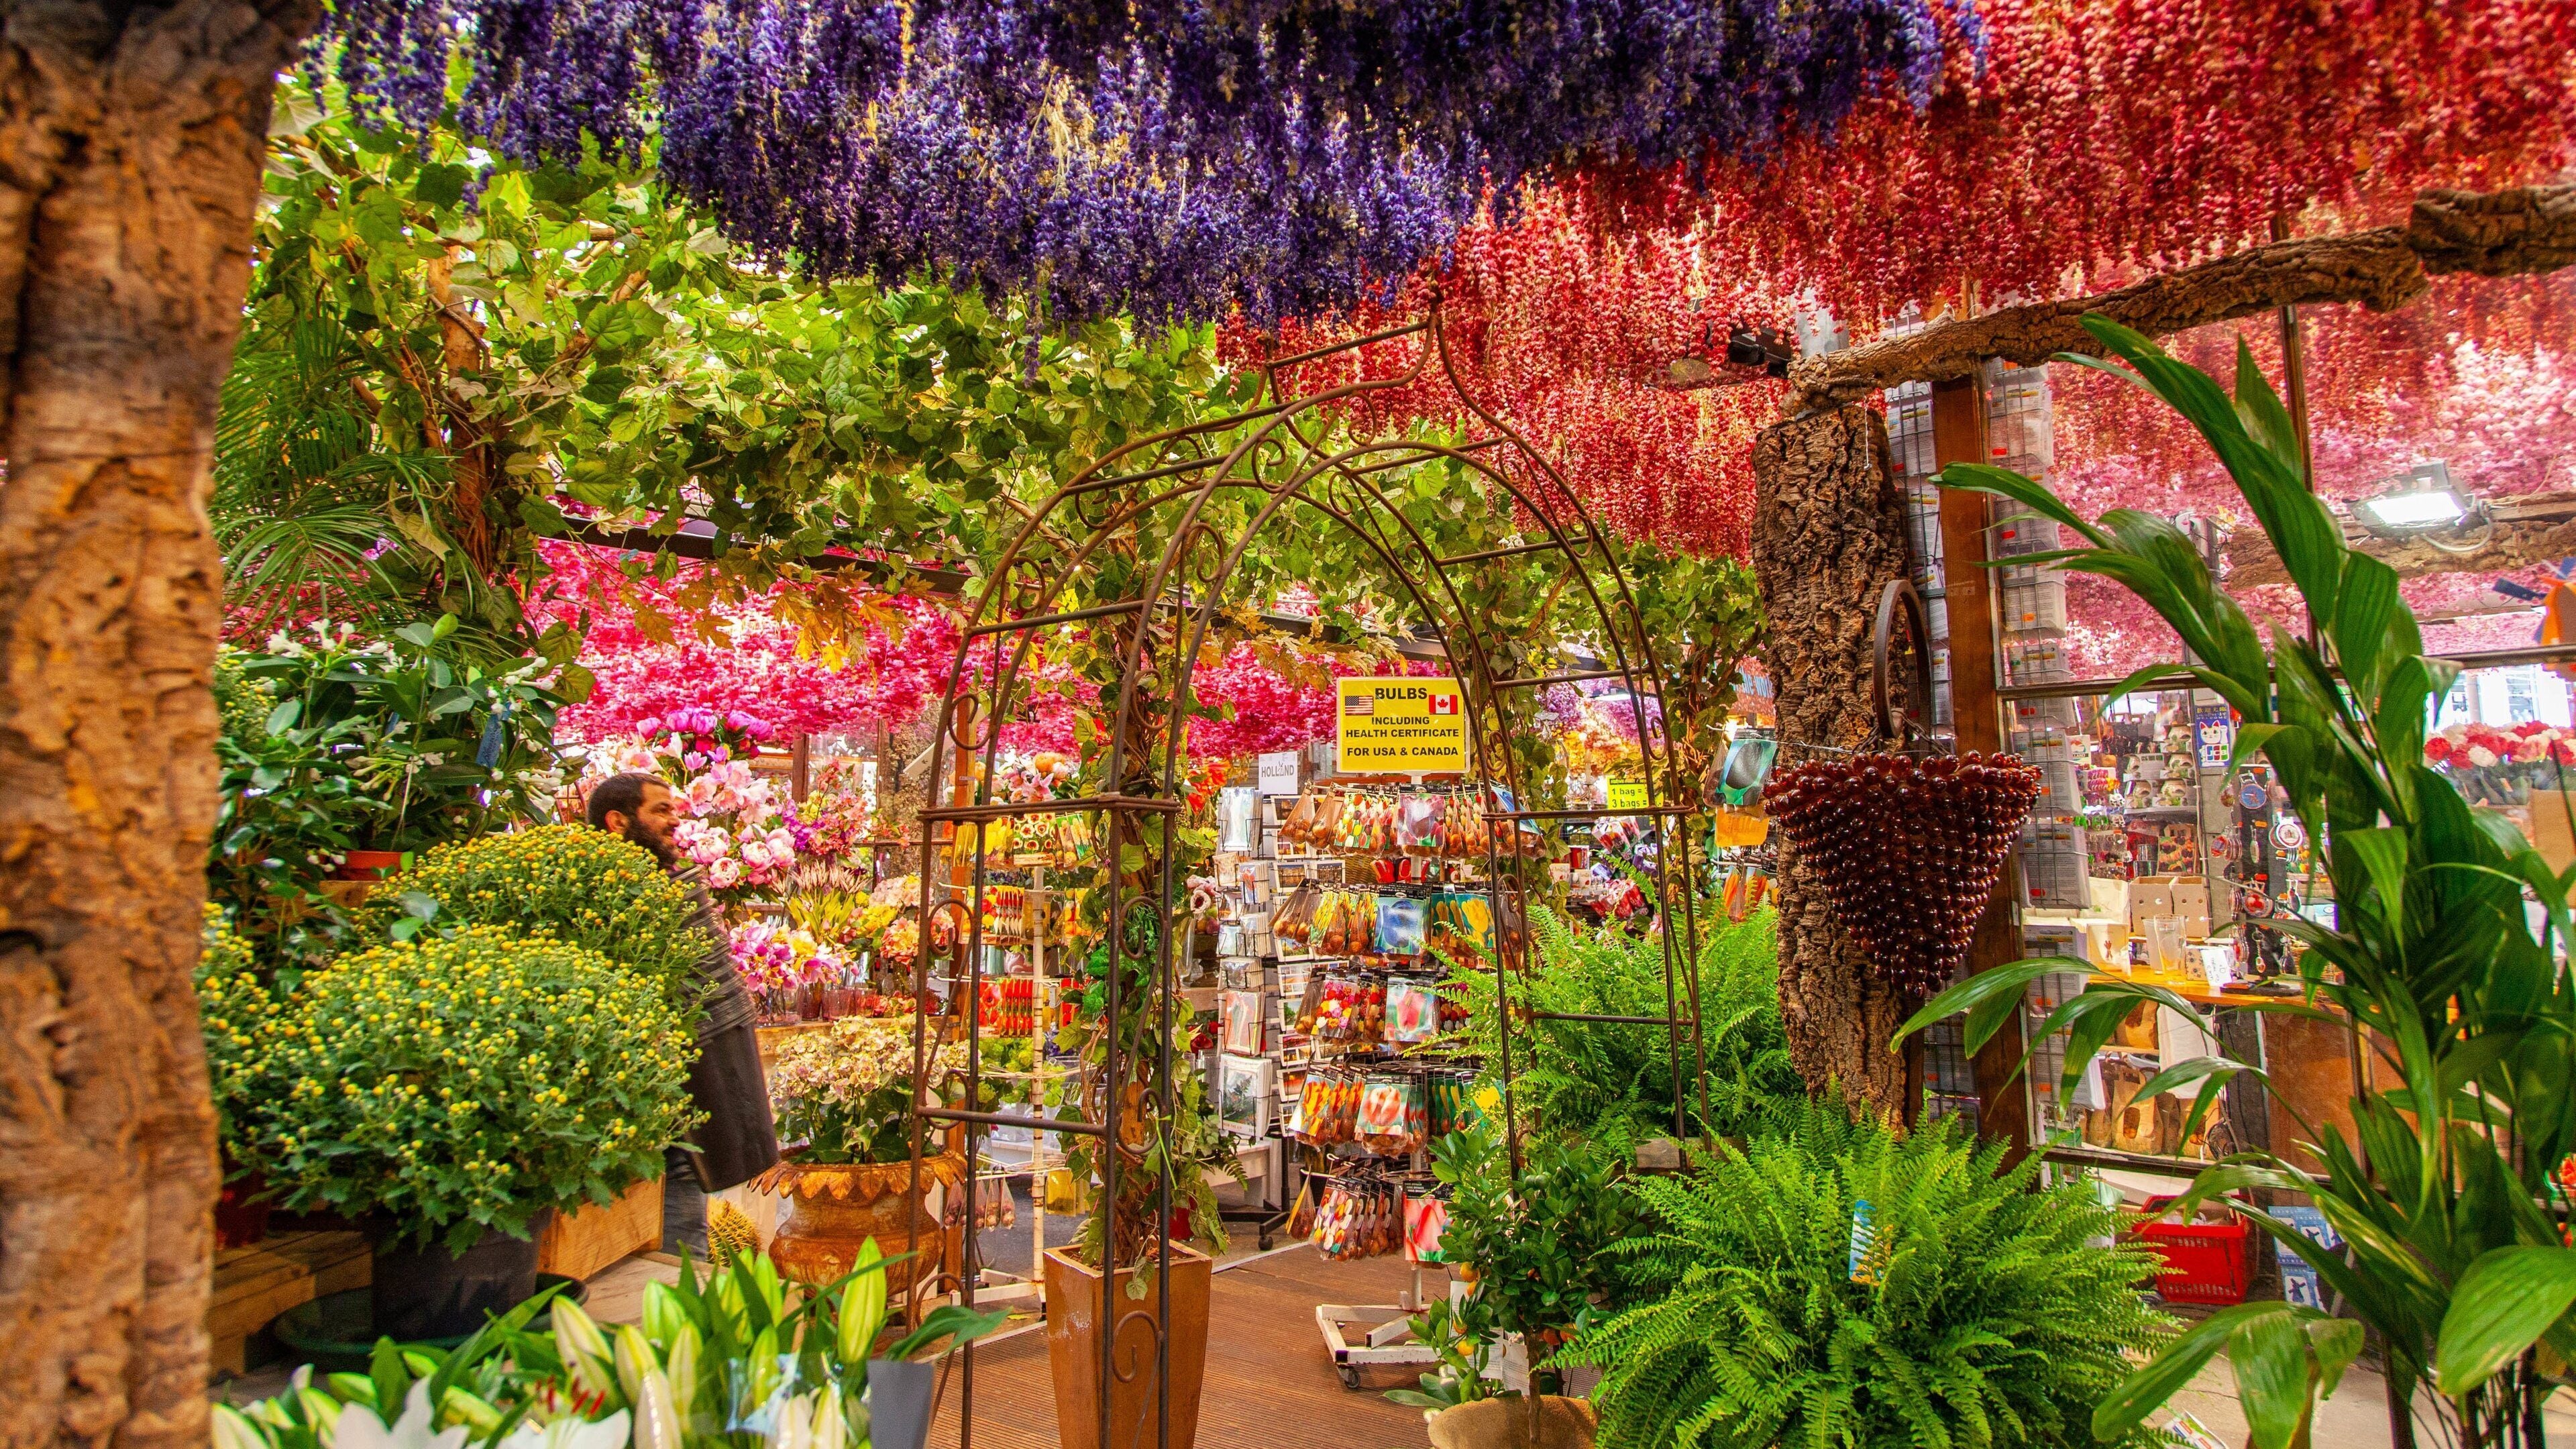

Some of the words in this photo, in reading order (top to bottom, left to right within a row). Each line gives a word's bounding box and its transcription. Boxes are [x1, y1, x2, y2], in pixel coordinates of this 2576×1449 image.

[1375, 688, 1428, 700] BULBS
[1371, 716, 1430, 725] INCLUDING
[1346, 729, 1387, 738] HEALTH
[1391, 729, 1459, 737] CERTIFICATE
[1347, 747, 1370, 756] FOR
[1373, 747, 1396, 756] USA
[1400, 747, 1408, 756] &
[1411, 747, 1458, 755] CANADA
[1619, 788, 1635, 796] bag
[1612, 799, 1617, 808] 3
[1620, 799, 1641, 809] bags
